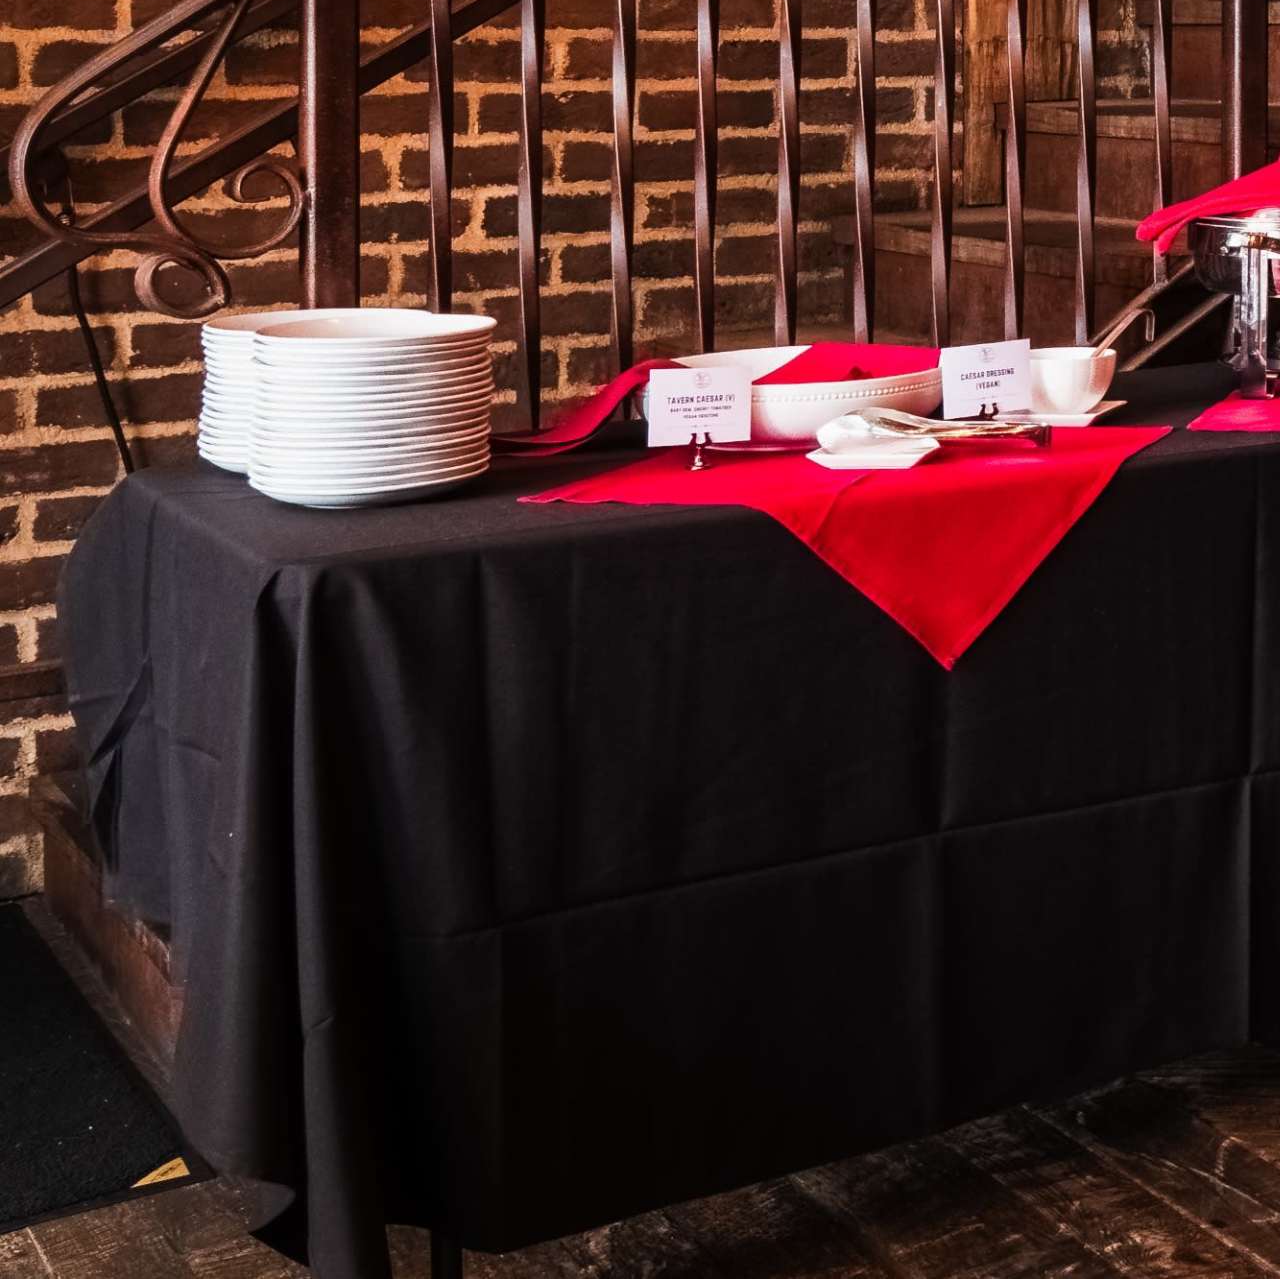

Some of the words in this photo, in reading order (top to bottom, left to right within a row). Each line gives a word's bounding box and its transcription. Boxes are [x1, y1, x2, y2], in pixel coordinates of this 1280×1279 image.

[960, 371, 985, 381] CAESAR
[986, 367, 1015, 378] DRESSING
[976, 380, 1000, 391] (VEGAN)
[667, 396, 694, 405] TAVERN
[696, 394, 723, 404] CAESAR
